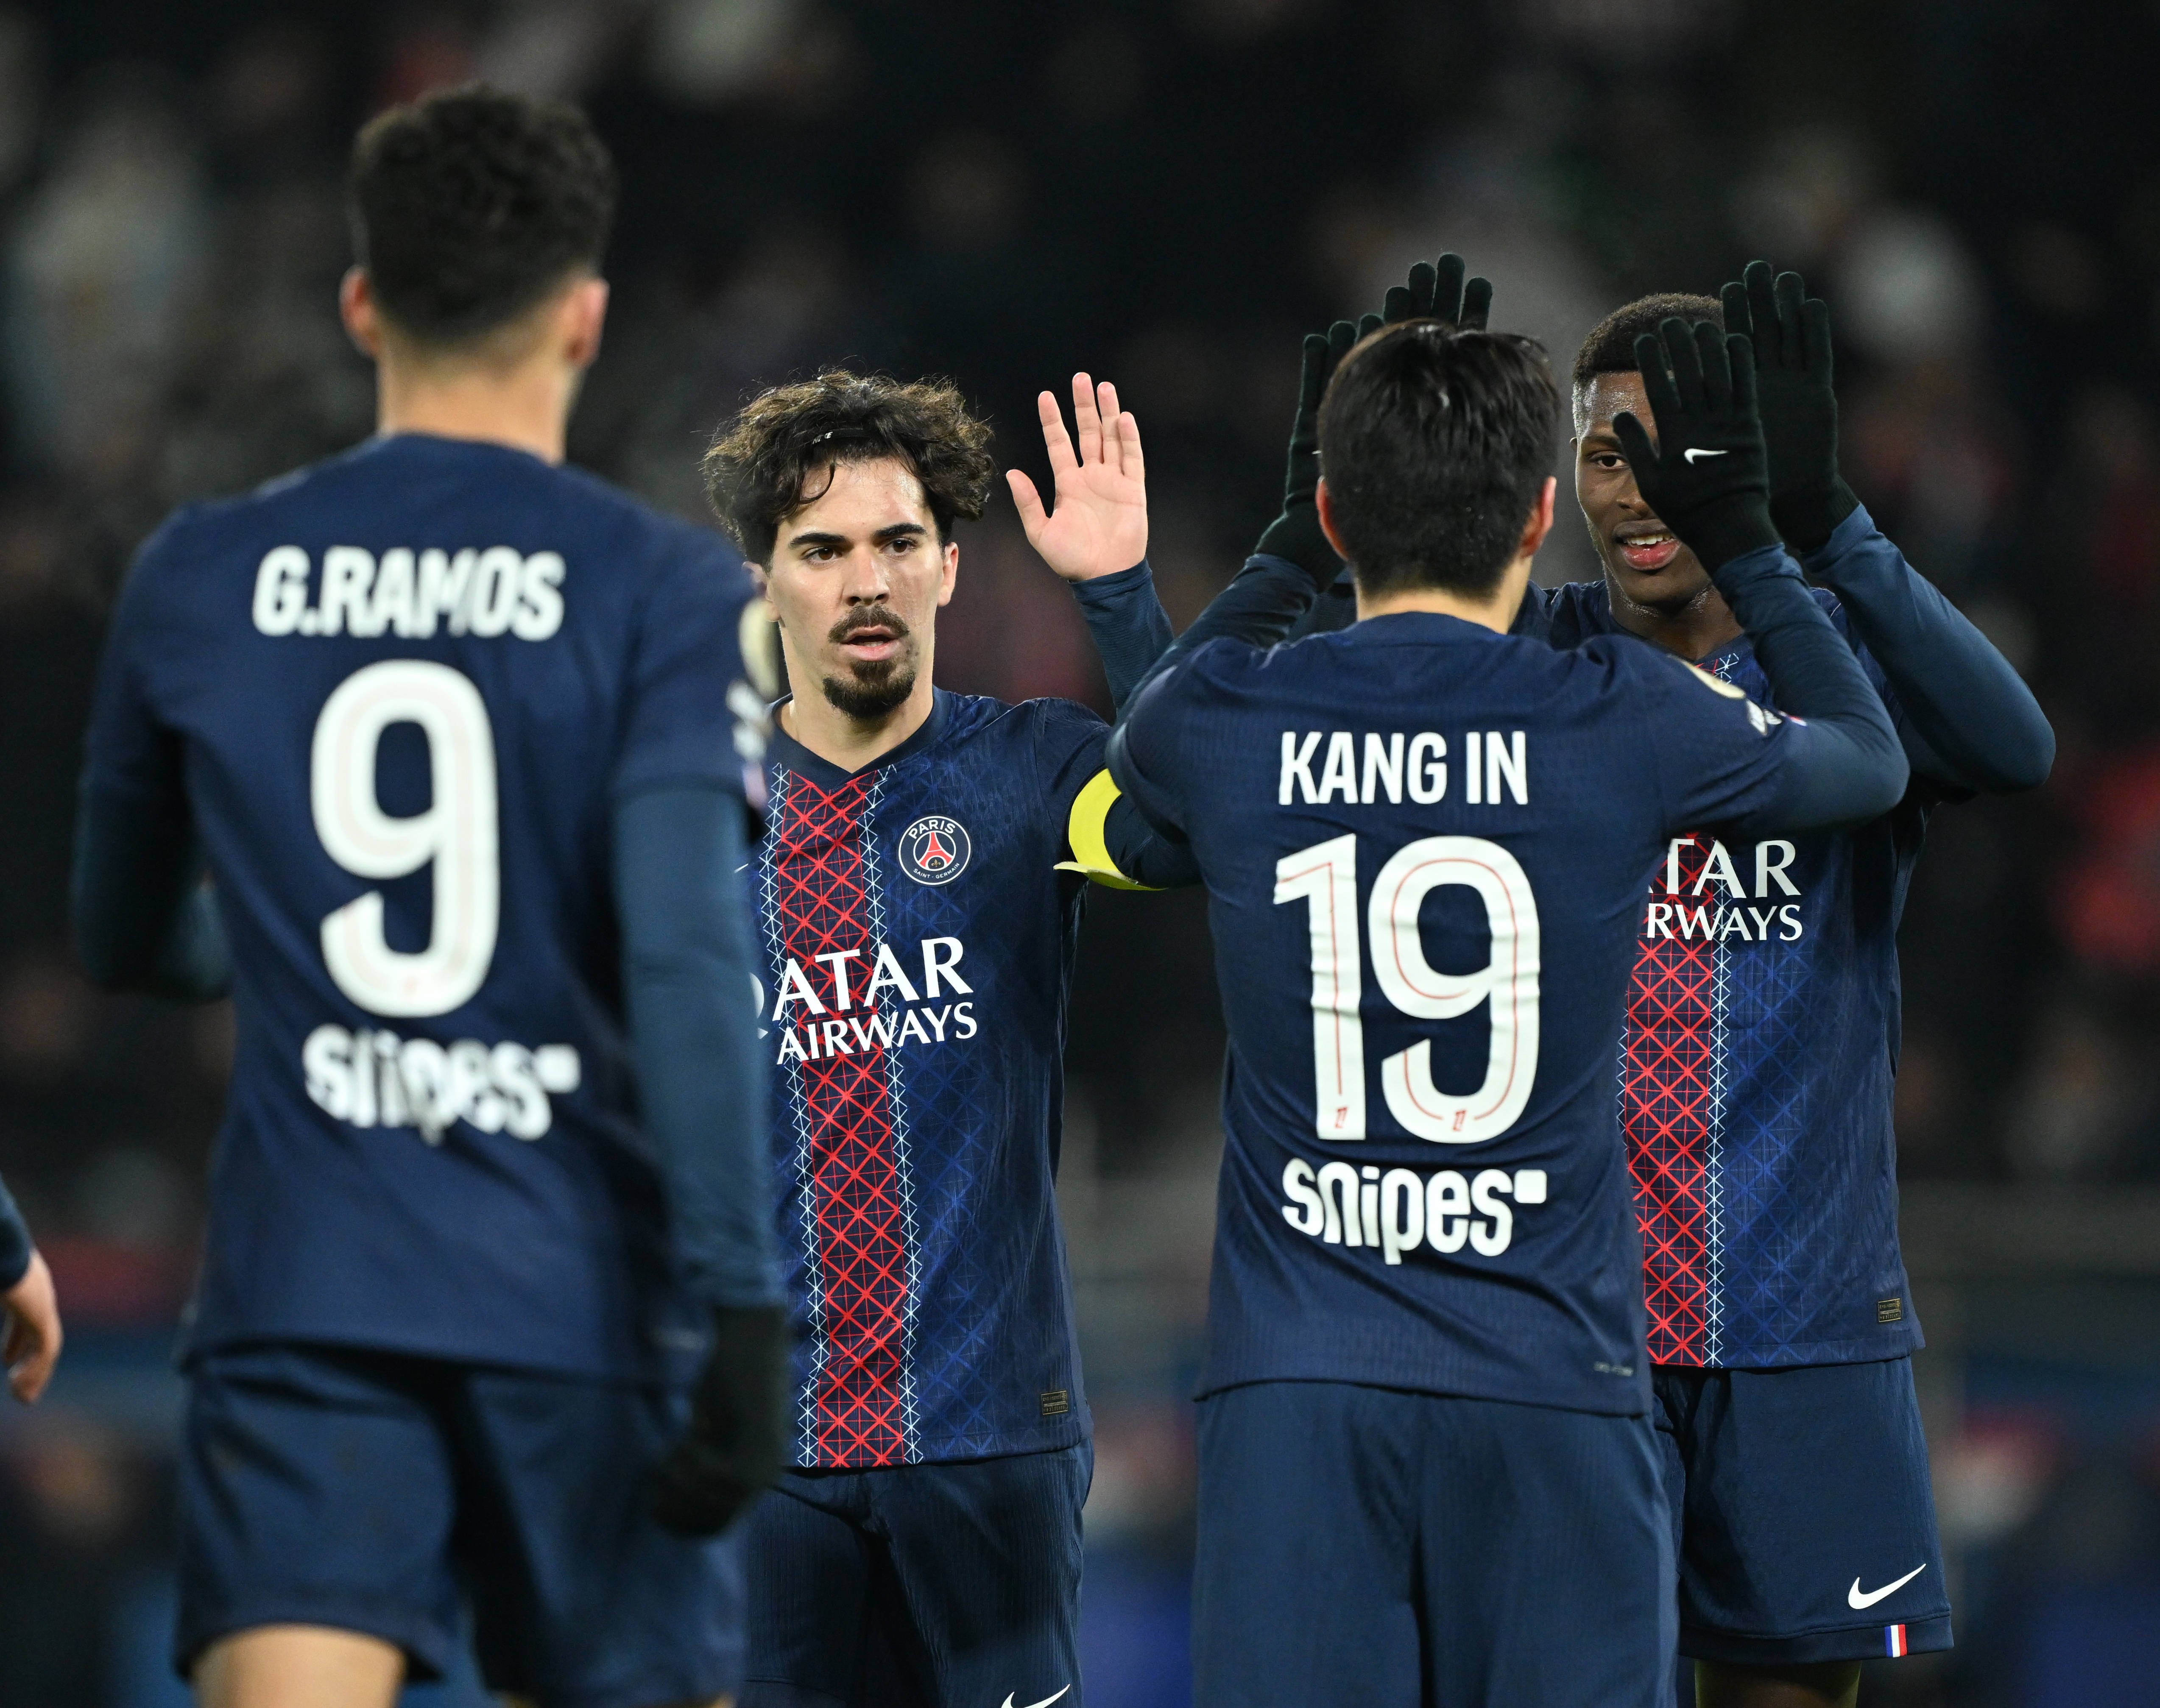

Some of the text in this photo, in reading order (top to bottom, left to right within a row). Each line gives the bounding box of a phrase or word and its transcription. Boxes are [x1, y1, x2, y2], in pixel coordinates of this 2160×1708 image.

[252, 545, 565, 641] G.RAMOS
[1279, 731, 1528, 805] KANG IN
[310, 659, 500, 1017] 9
[908, 819, 955, 839] PARIS
[1648, 838, 1802, 898] TAR
[1647, 903, 1803, 941] RWAYS
[1273, 833, 1540, 1144] 19
[776, 1002, 977, 1065] AIRWAYS
[1282, 1157, 1513, 1265] snipes
